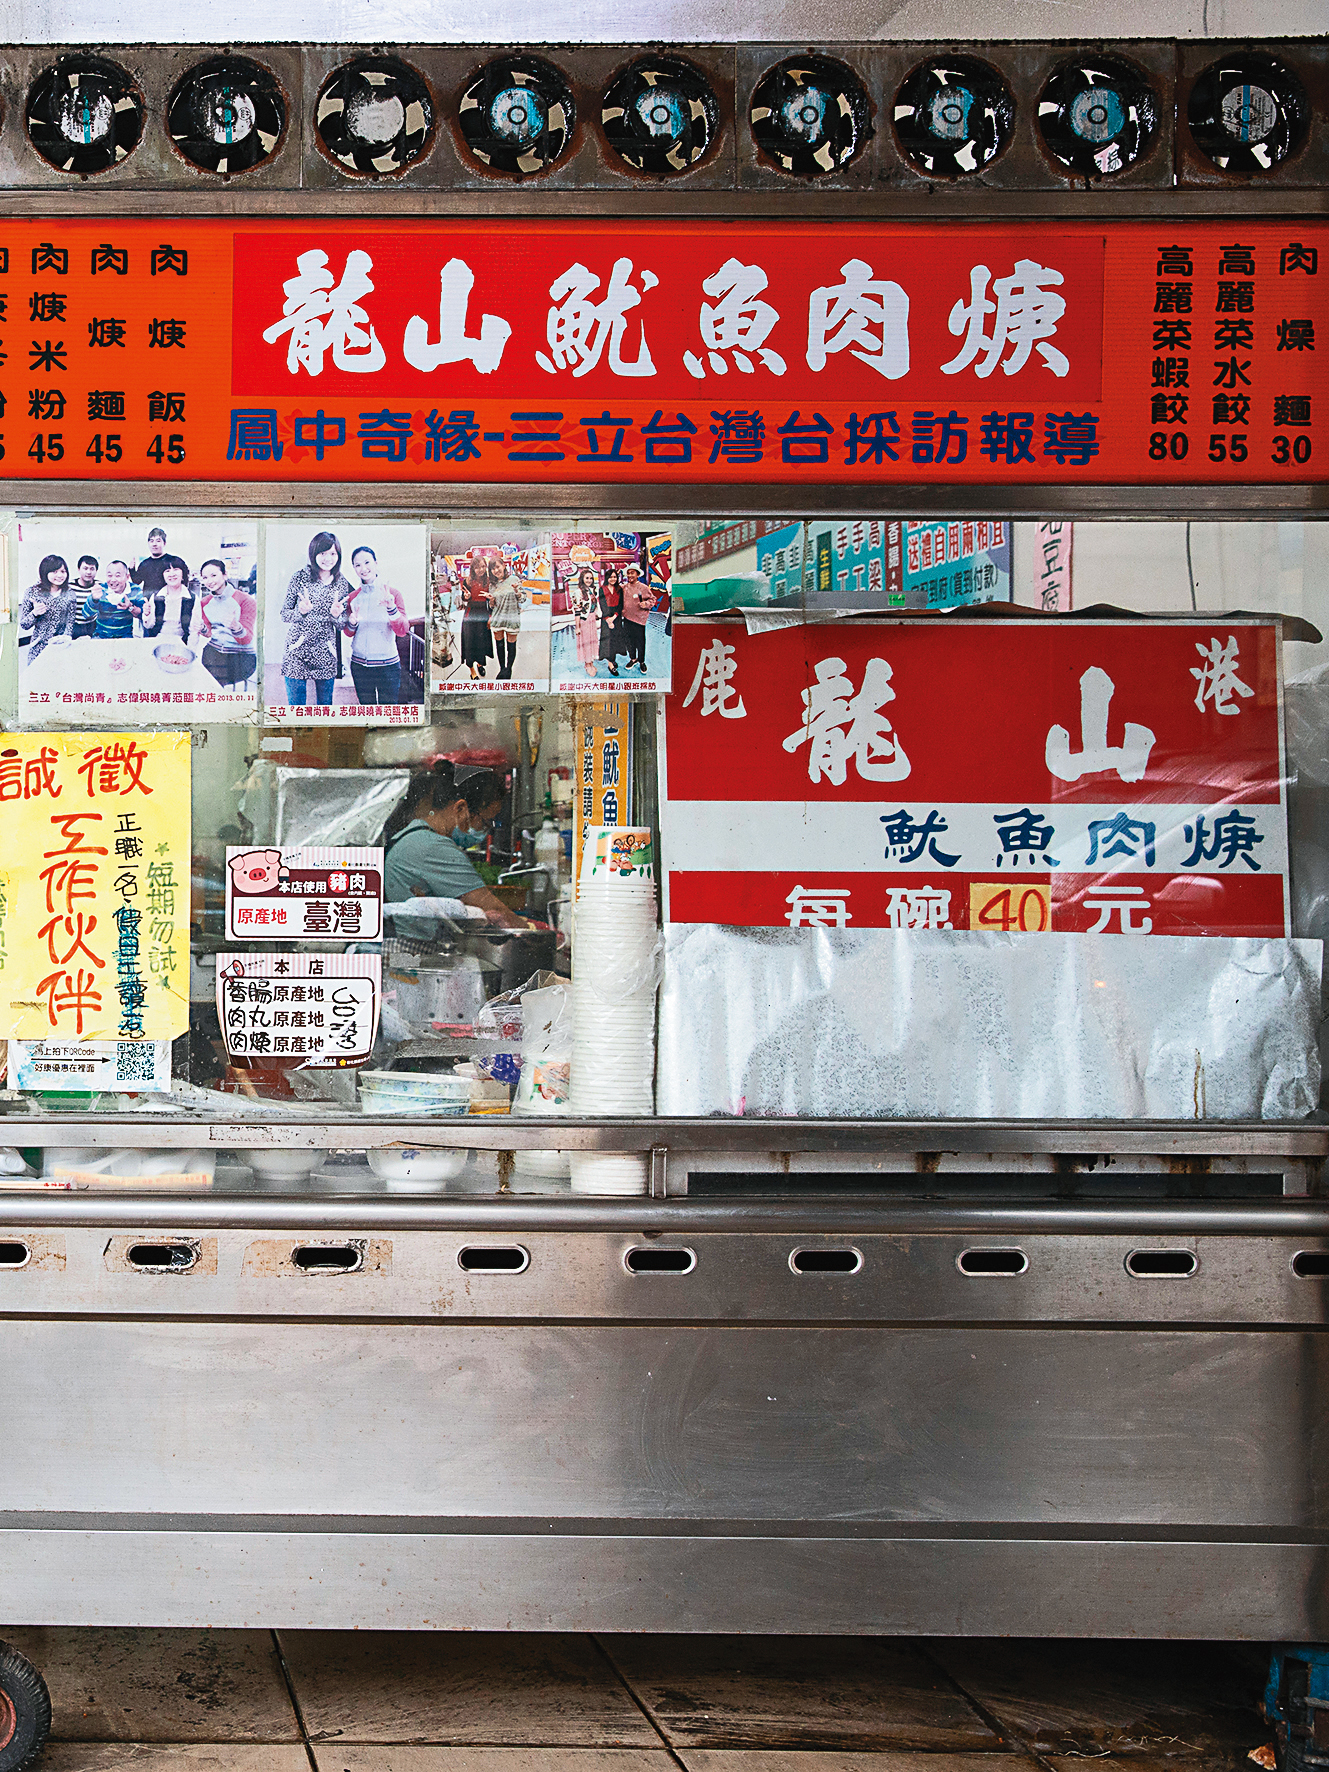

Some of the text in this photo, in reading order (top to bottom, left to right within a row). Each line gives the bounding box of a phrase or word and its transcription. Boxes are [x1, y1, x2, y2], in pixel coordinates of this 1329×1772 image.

[263, 248, 1071, 380] 龍山魷魚肉焿
[1148, 245, 1194, 460] 高麗菜蝦餃 80
[1208, 243, 1256, 462] 高麗菜水餃 55
[1271, 242, 1318, 464] 肉燥麵 30
[27, 433, 65, 463] 45
[85, 434, 123, 463] 45
[146, 434, 186, 464] 45
[682, 636, 1255, 719] 鹿 港
[782, 658, 1157, 786] 龍山
[880, 809, 1266, 873] 魷魚肉焿
[35, 812, 109, 1035] 工作伙伴
[145, 861, 178, 974] 短期勿試
[237, 900, 362, 934] 原產地 臺灣
[278, 872, 366, 894] 本店使用豬肉
[274, 959, 324, 975] 本店
